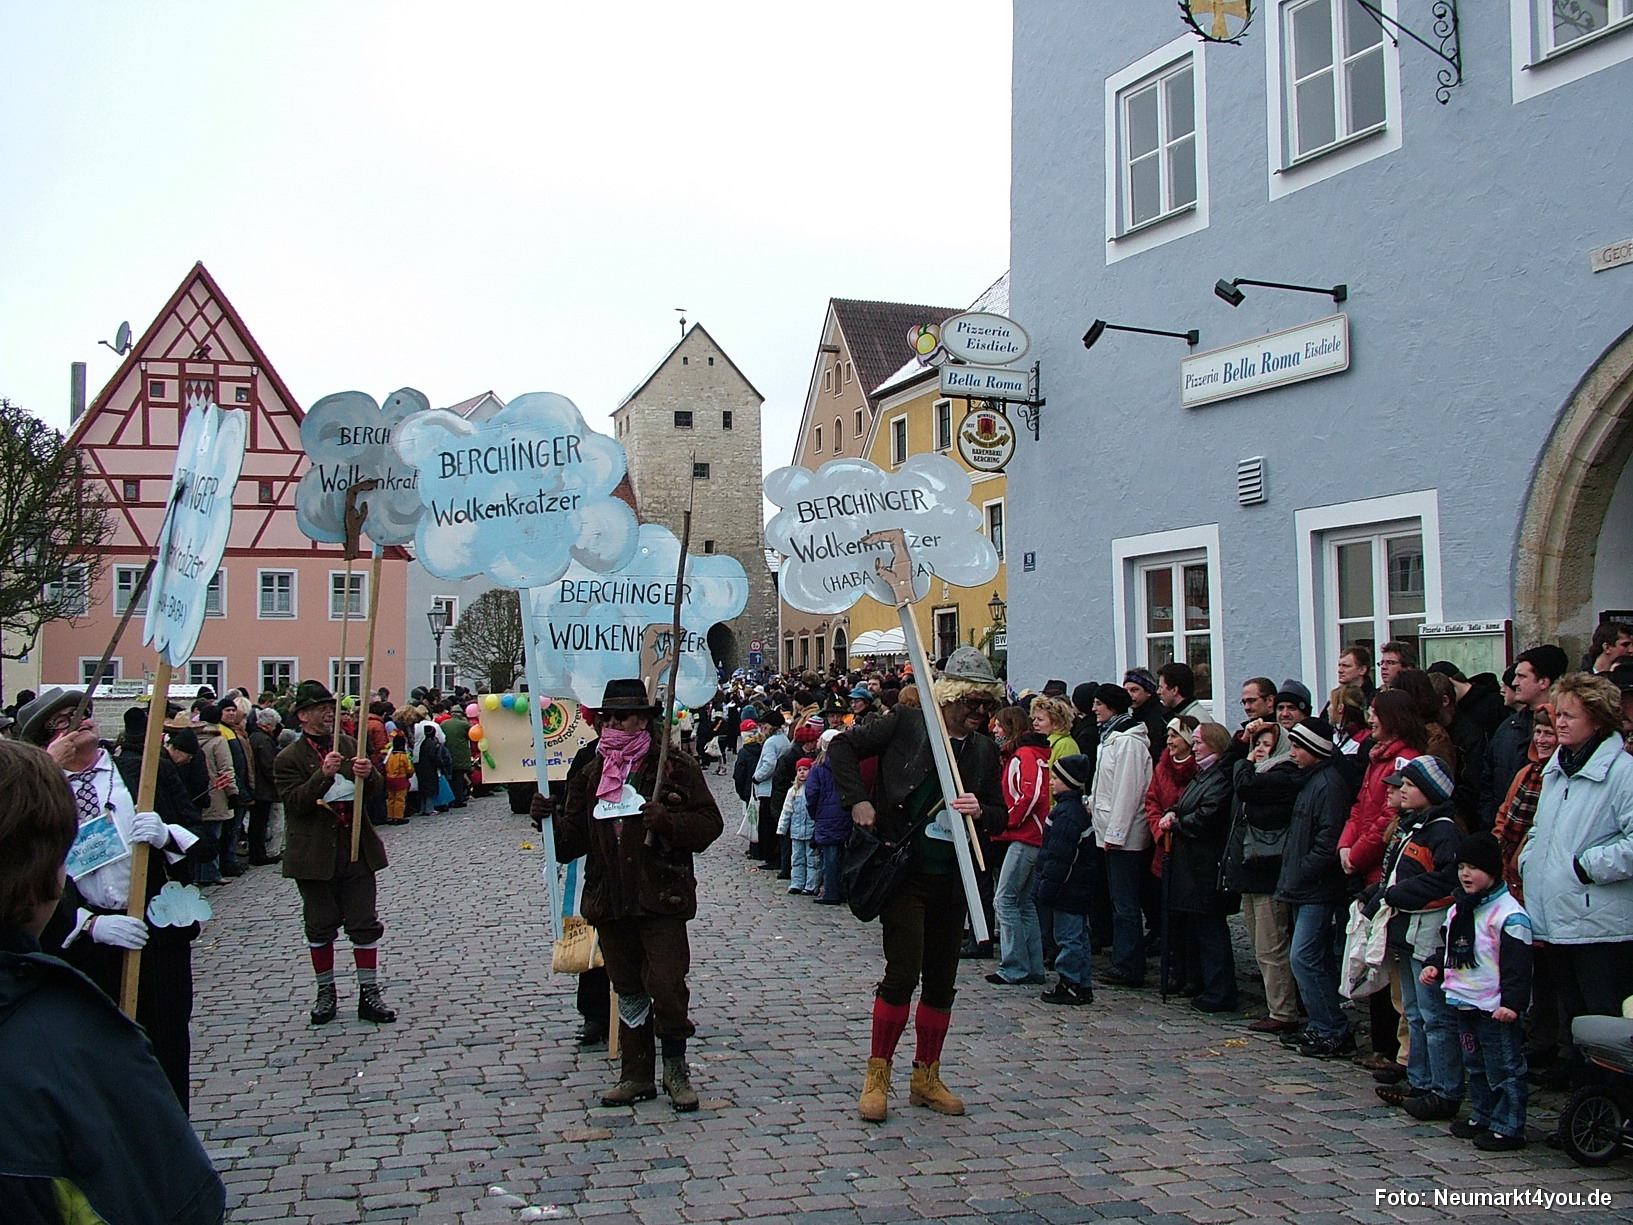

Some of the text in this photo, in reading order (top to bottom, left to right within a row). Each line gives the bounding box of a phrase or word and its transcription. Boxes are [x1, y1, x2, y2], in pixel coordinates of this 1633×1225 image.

[956, 321, 1010, 337] Pizzeria
[966, 337, 1019, 354] Eisdiele
[1185, 335, 1341, 390] Pizzeria Bella Roma Eisdiele
[947, 372, 1022, 391] Bella Roma
[336, 426, 392, 446] BERCH
[974, 456, 1000, 464] BERCHING
